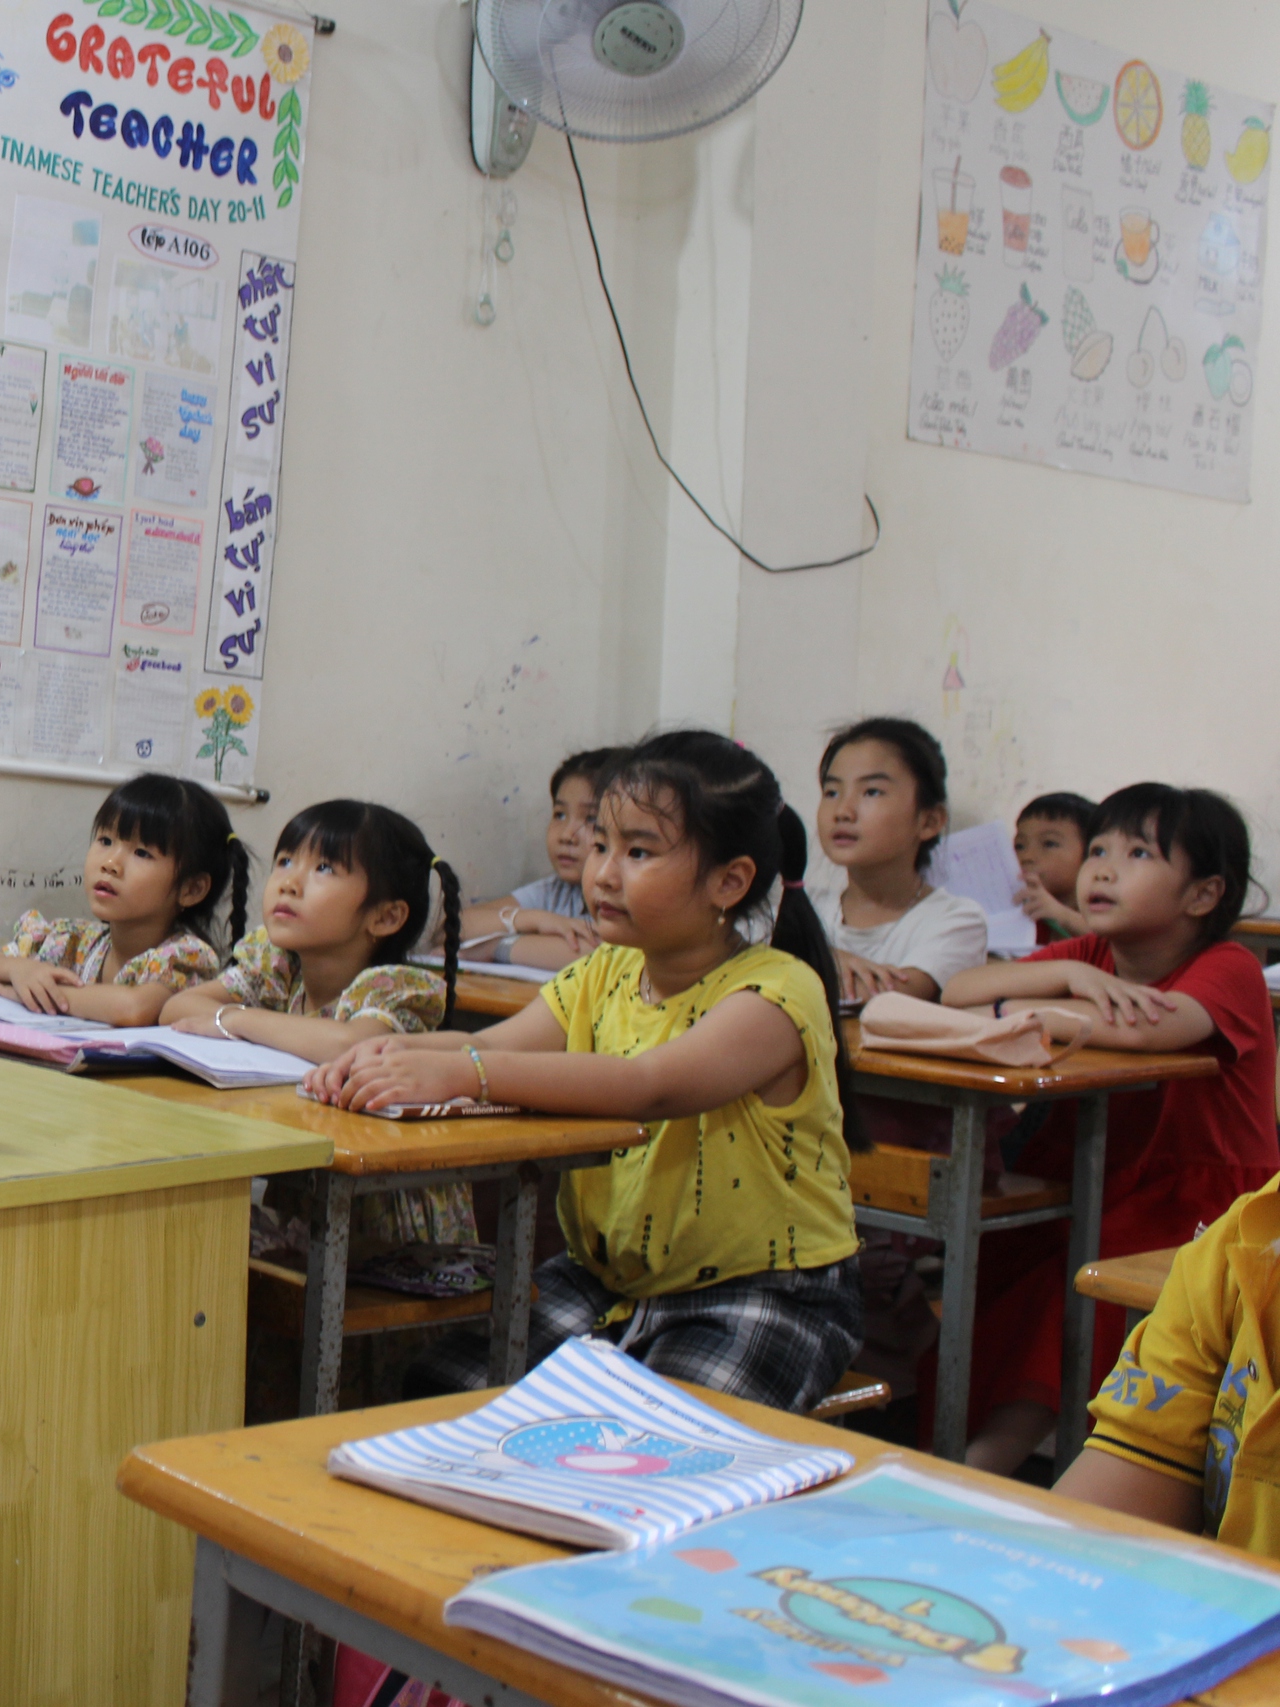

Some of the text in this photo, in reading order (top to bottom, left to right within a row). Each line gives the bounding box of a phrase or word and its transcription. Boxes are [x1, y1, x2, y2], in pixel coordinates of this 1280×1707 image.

[46, 12, 276, 121] GRATEFUL
[60, 90, 258, 186] TEACHER
[92, 167, 180, 217] TEACHER'S
[187, 194, 221, 224] DAY
[228, 196, 266, 223] 20-11
[168, 235, 211, 262] A106
[224, 487, 272, 534] bán
